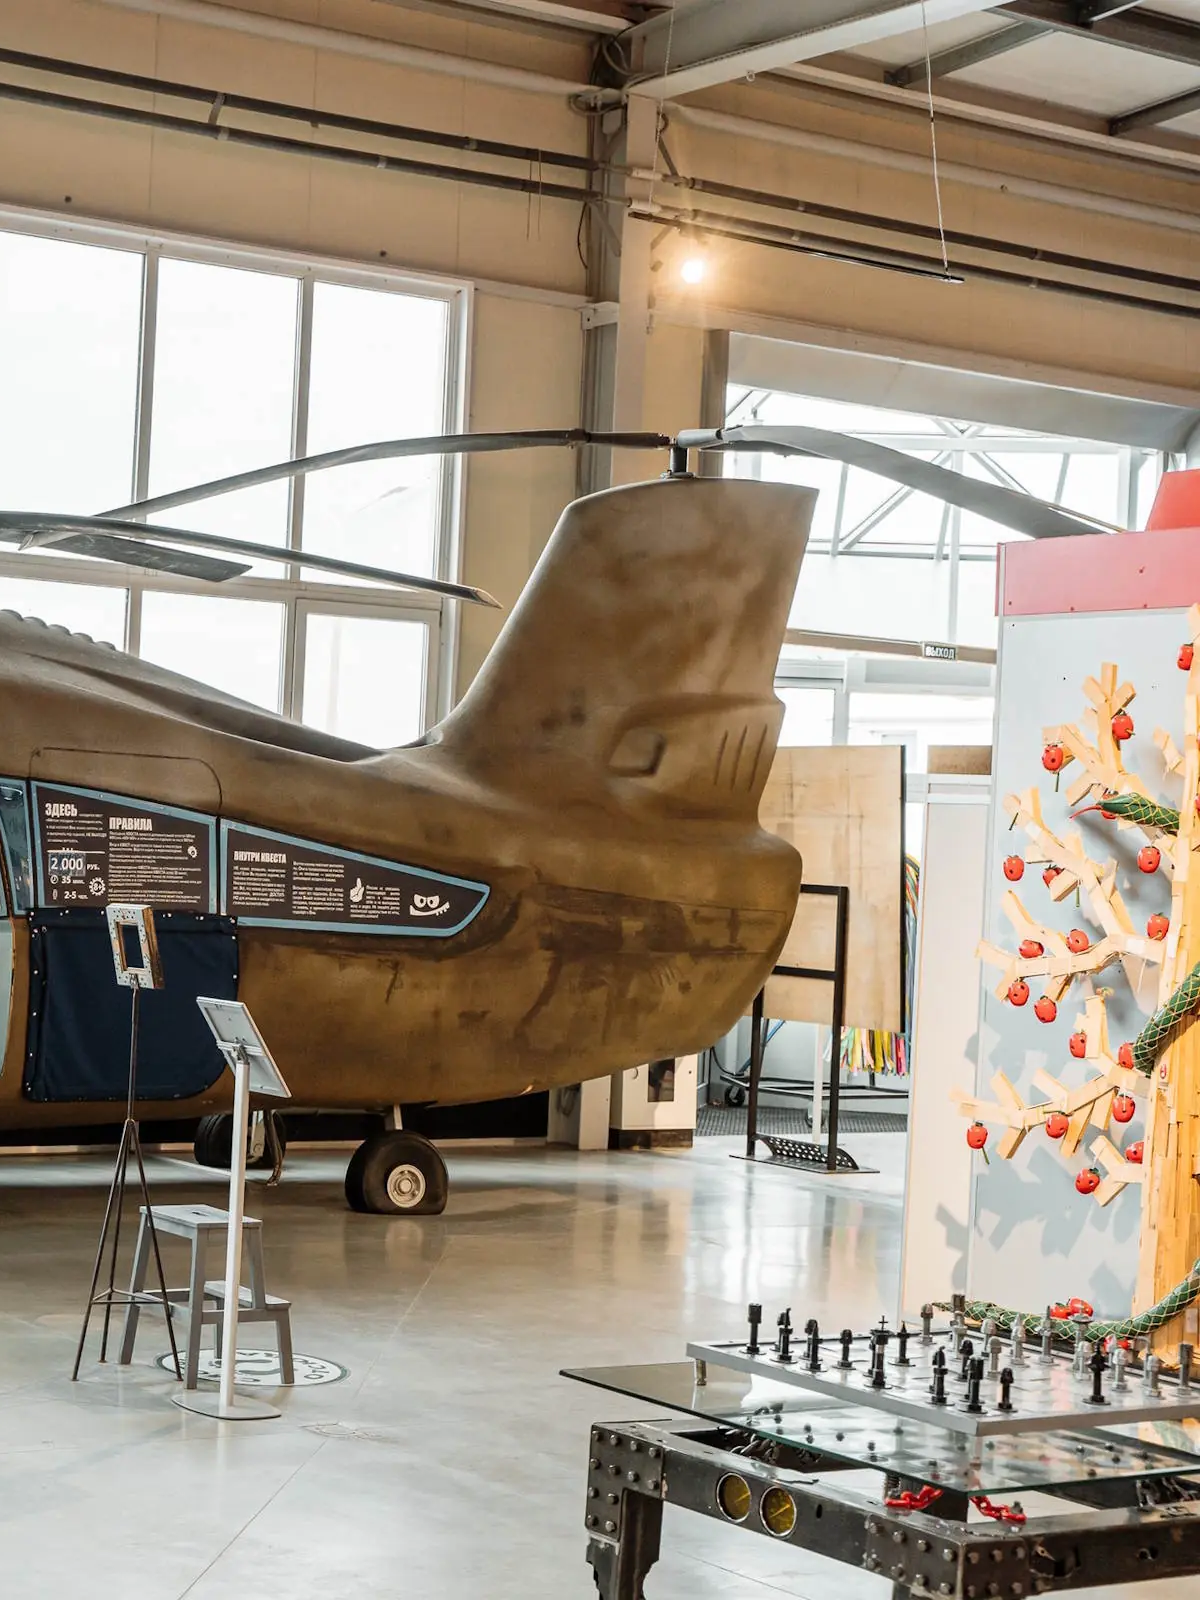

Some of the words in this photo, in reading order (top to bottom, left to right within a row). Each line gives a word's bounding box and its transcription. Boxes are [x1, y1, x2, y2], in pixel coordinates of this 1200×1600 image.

[925, 646, 955, 660] ВЫХОД
[45, 802, 78, 818] ЗДЕСЬ
[109, 816, 153, 831] ПРАВИЛА
[234, 850, 260, 862] ВНУТРИ
[261, 852, 287, 864] КВЕСТА
[61, 875, 71, 884] 35
[64, 890, 77, 899] 2-5
